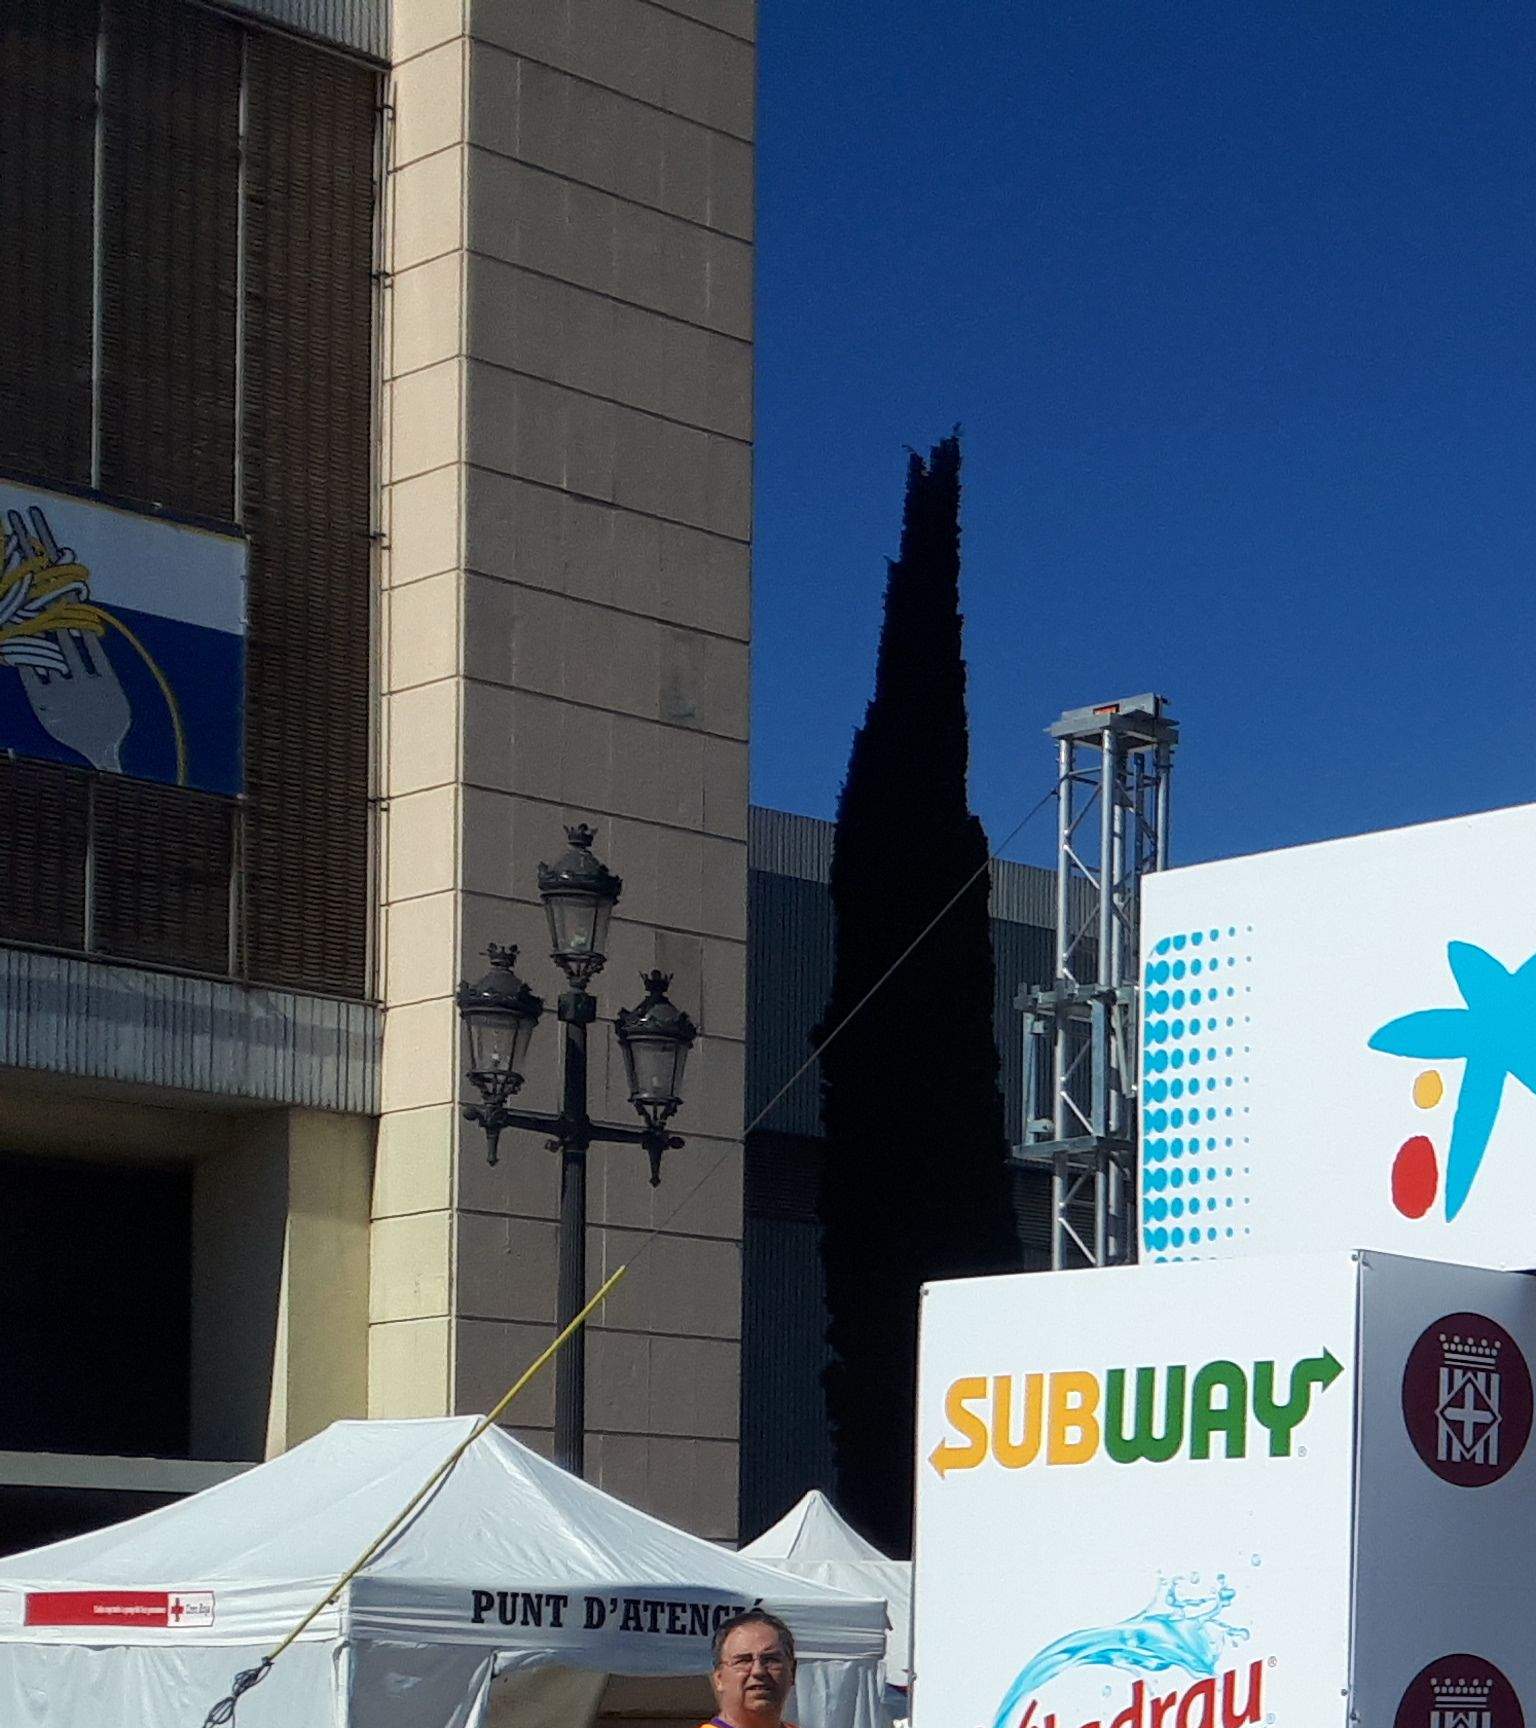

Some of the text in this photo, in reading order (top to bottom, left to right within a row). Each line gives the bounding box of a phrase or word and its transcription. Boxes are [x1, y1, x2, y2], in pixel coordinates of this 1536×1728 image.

[930, 1348, 1335, 1476] SUBWAY
[471, 1589, 766, 1637] PUNT D'ATENC
